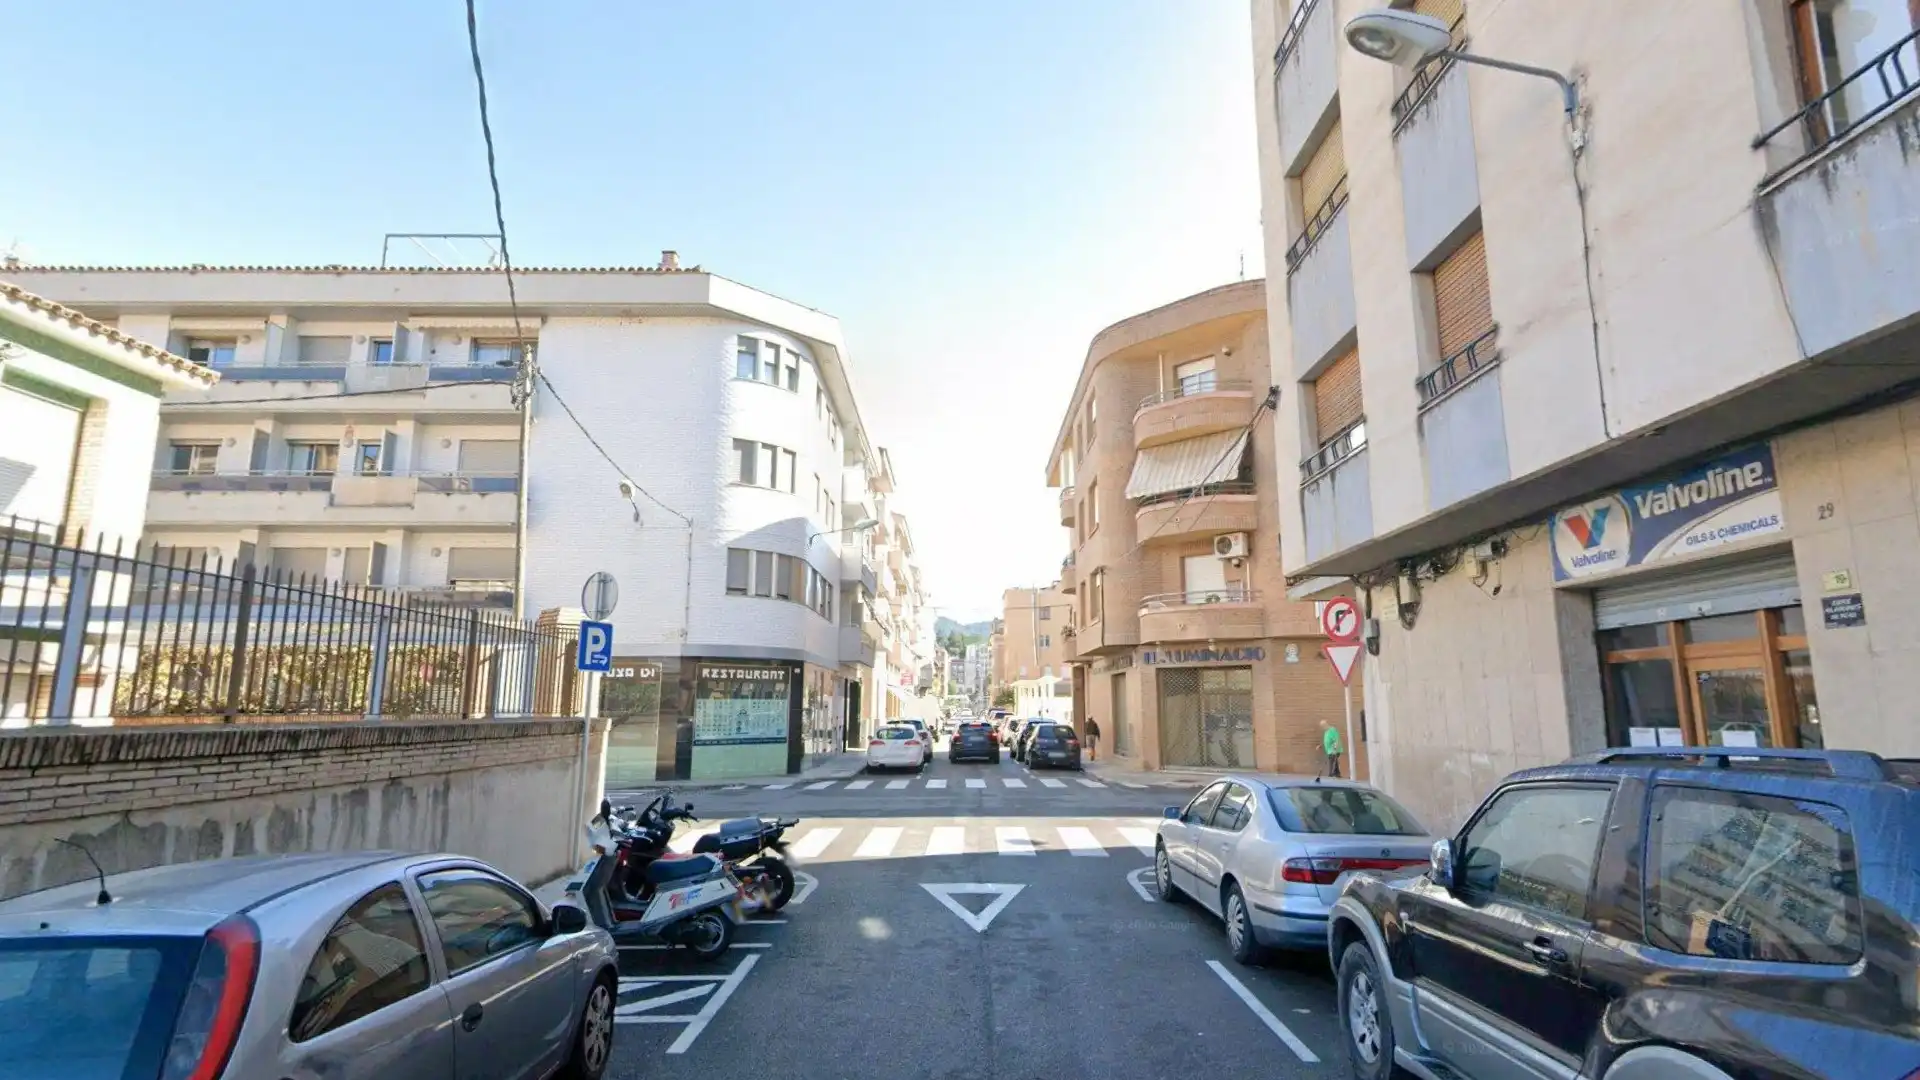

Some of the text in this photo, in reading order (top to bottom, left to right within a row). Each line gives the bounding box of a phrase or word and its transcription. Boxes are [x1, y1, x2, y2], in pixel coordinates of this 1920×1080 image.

[1635, 460, 1764, 520] Valvoline
[1818, 502, 1835, 521] 29
[1685, 515, 1780, 547] OILS & CHEMICALS
[1570, 548, 1617, 570] Valvoline
[584, 627, 606, 665] P
[701, 667, 785, 680] RESTAURANT
